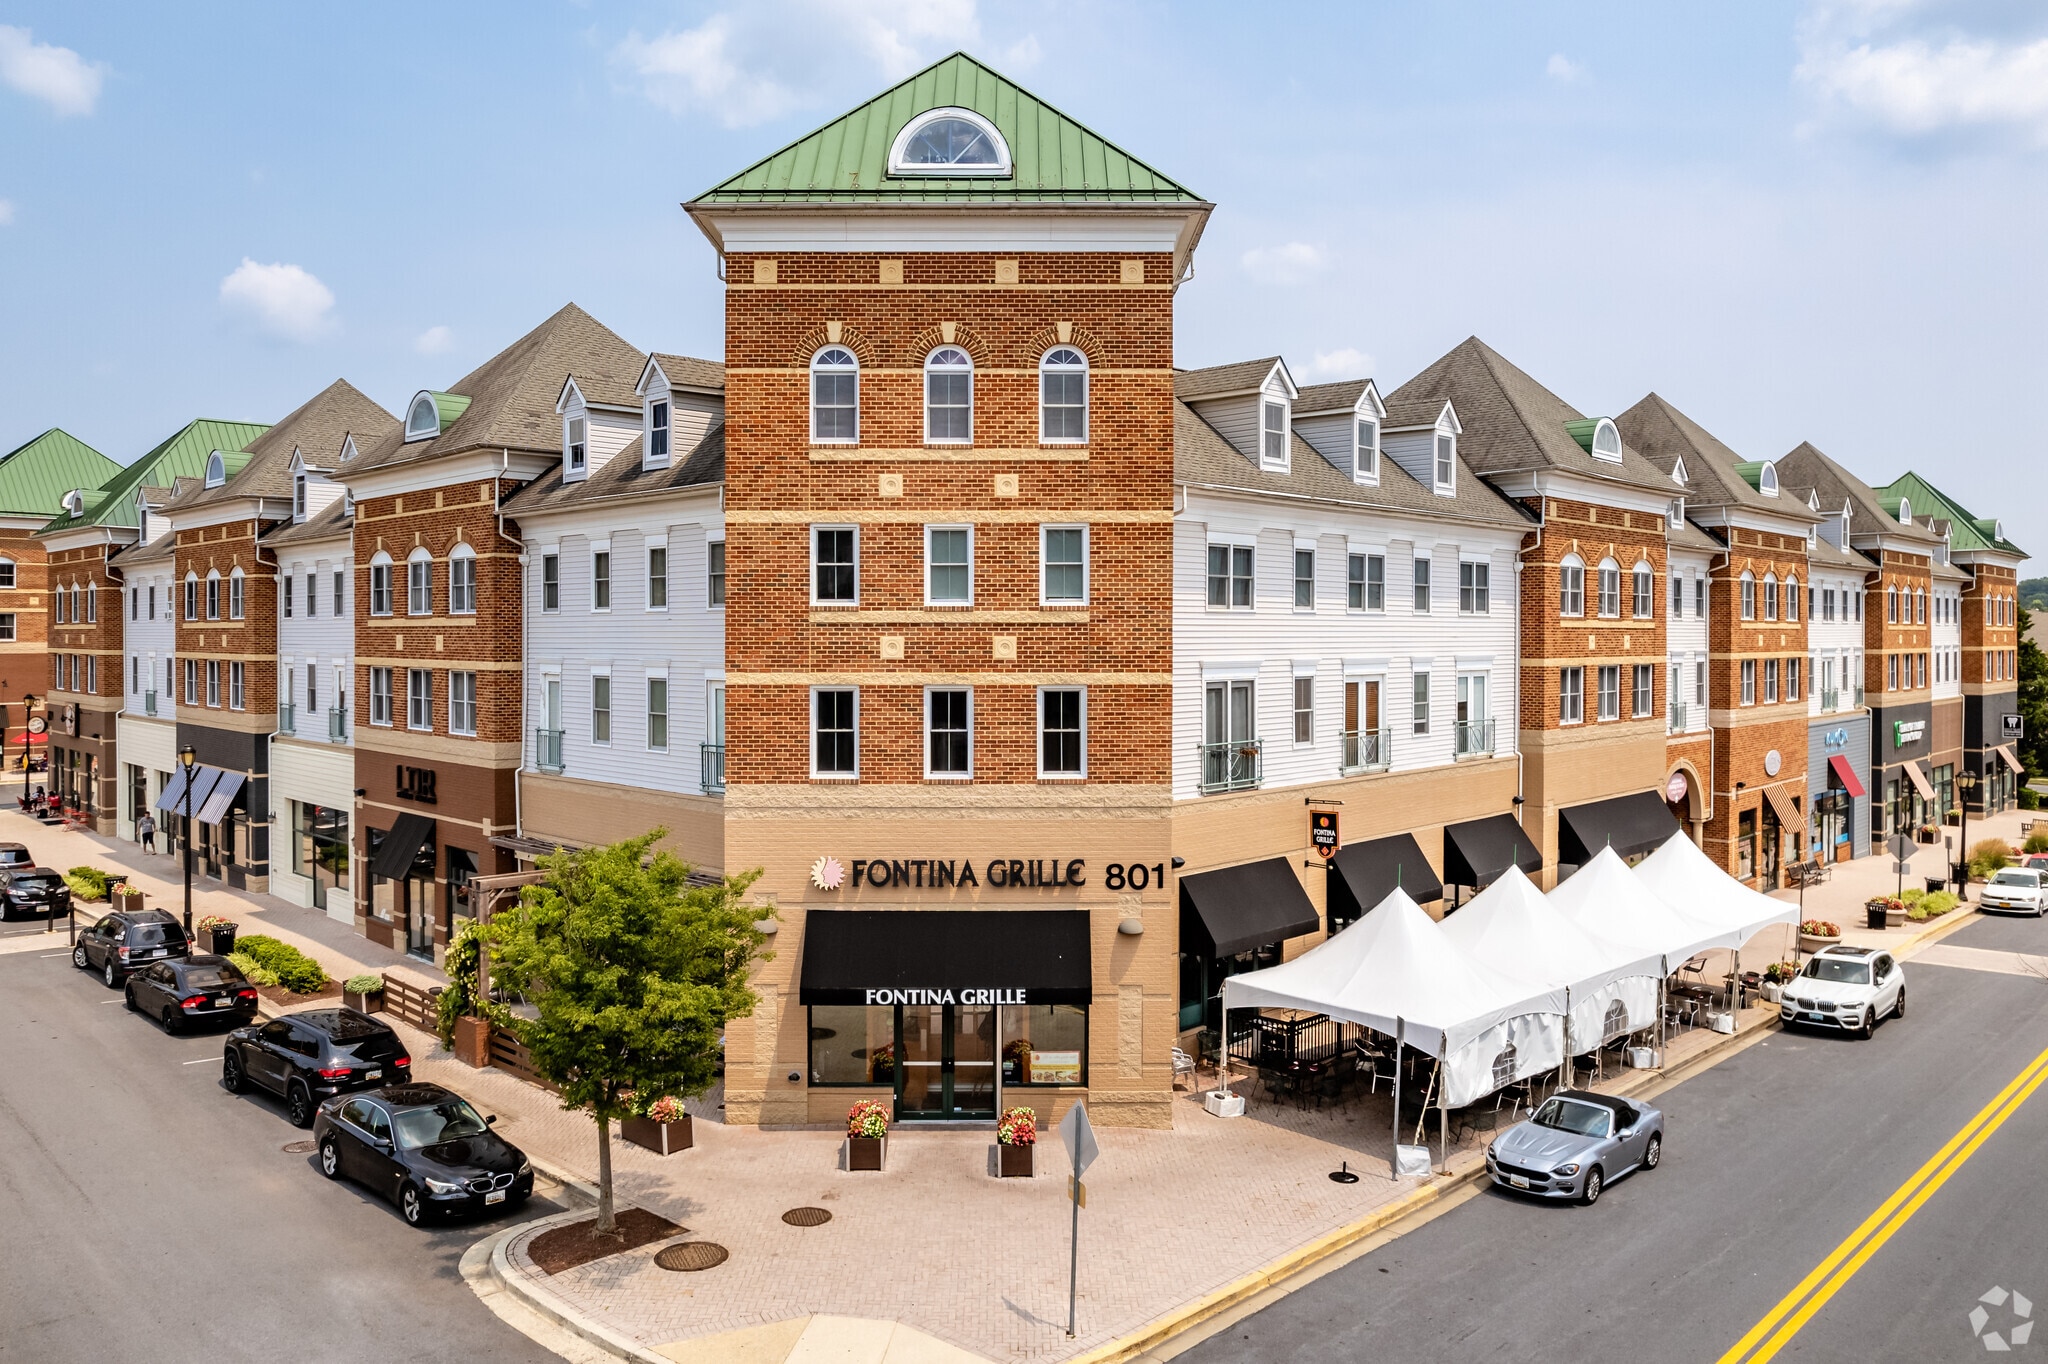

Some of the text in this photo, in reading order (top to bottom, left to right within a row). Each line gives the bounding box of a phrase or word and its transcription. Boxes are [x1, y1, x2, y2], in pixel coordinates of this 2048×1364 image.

[852, 858, 1087, 888] FONTINA GRILLE
[1105, 863, 1165, 891] 801
[865, 988, 1026, 1005] FONTINA GRILLE
